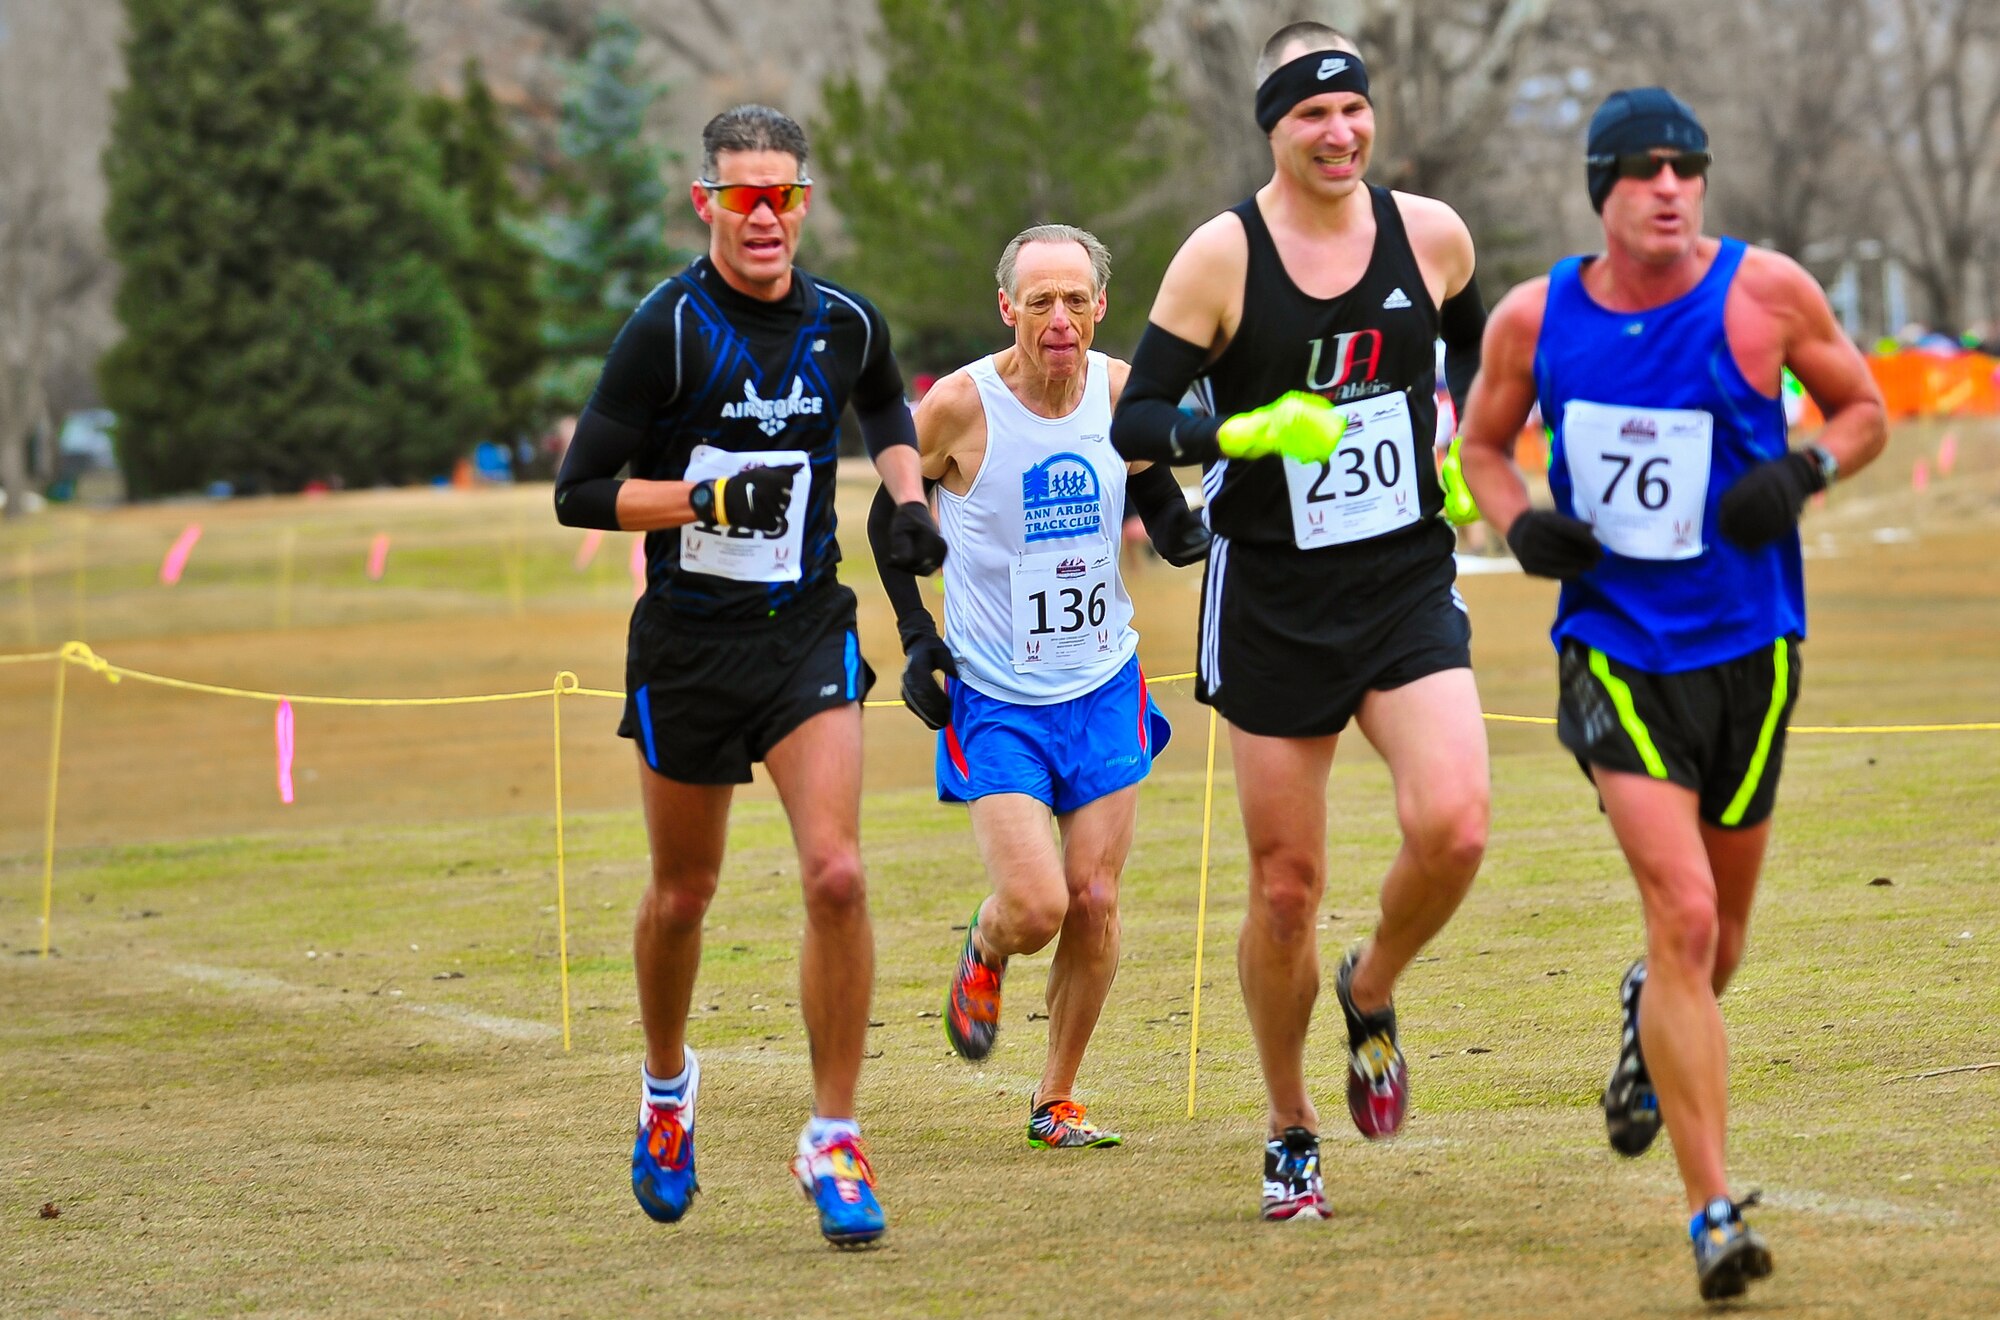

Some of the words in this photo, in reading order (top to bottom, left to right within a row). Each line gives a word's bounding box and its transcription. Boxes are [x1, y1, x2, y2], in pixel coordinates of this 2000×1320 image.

[720, 402, 758, 418] AIR
[760, 396, 823, 420] FORCE
[1306, 439, 1400, 504] 230
[1600, 453, 1671, 511] 76
[1025, 503, 1050, 521] ANN
[1056, 498, 1100, 517] ARBOR
[1025, 518, 1067, 533] TRACK
[1069, 515, 1100, 528] CLUB
[1028, 581, 1106, 635] 136
